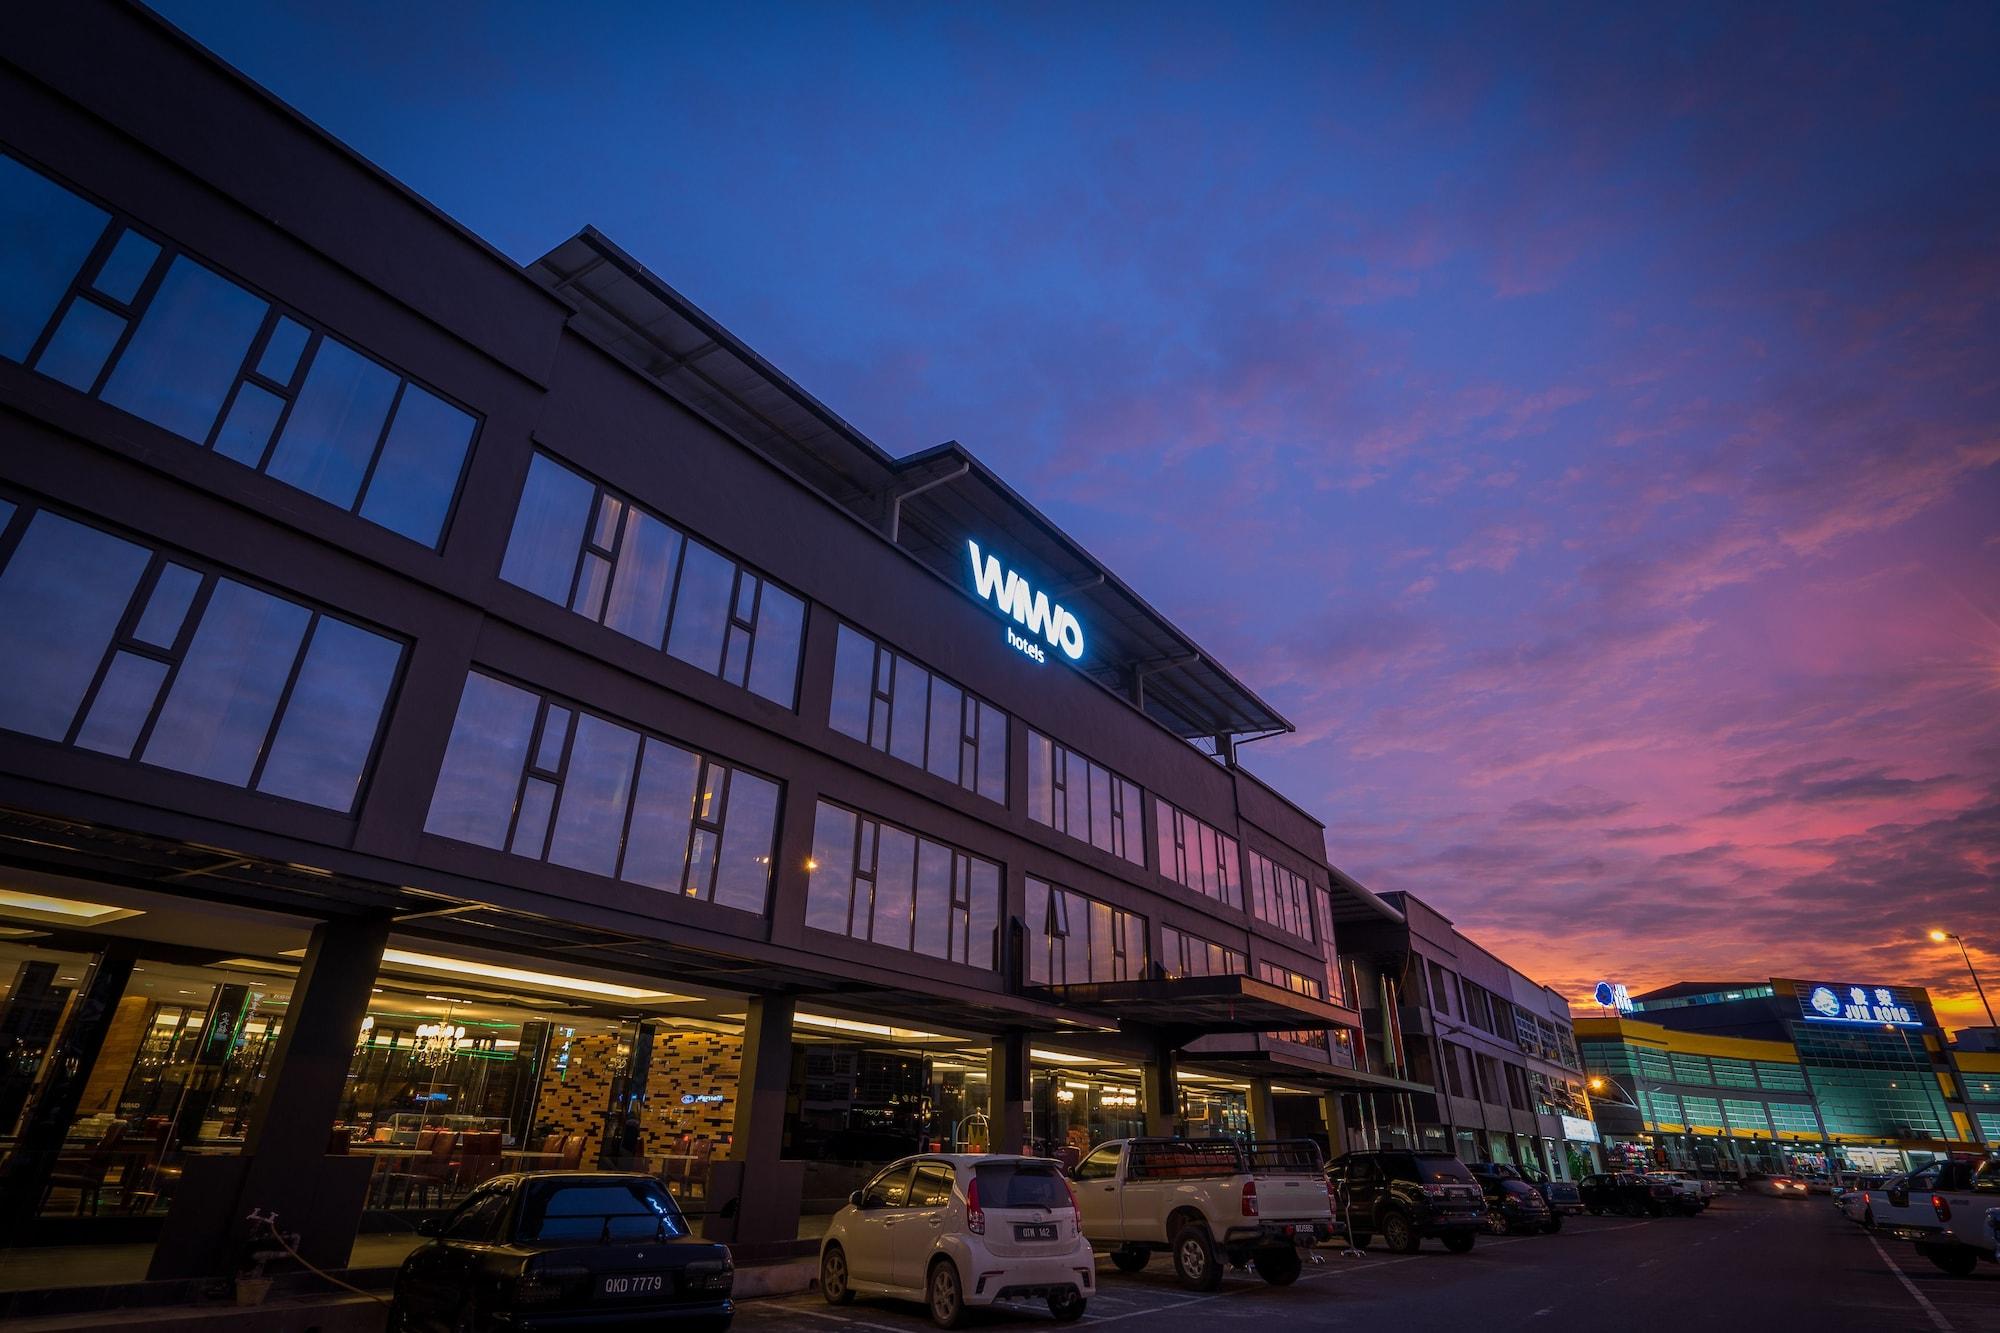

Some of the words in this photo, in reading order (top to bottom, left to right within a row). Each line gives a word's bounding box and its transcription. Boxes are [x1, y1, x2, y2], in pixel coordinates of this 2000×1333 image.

[1007, 627, 1045, 664] hotels
[1845, 1004, 1870, 1020] JUN
[1873, 1006, 1911, 1022] RONG
[605, 1278, 628, 1293] QKD
[632, 1275, 662, 1292] 7779
